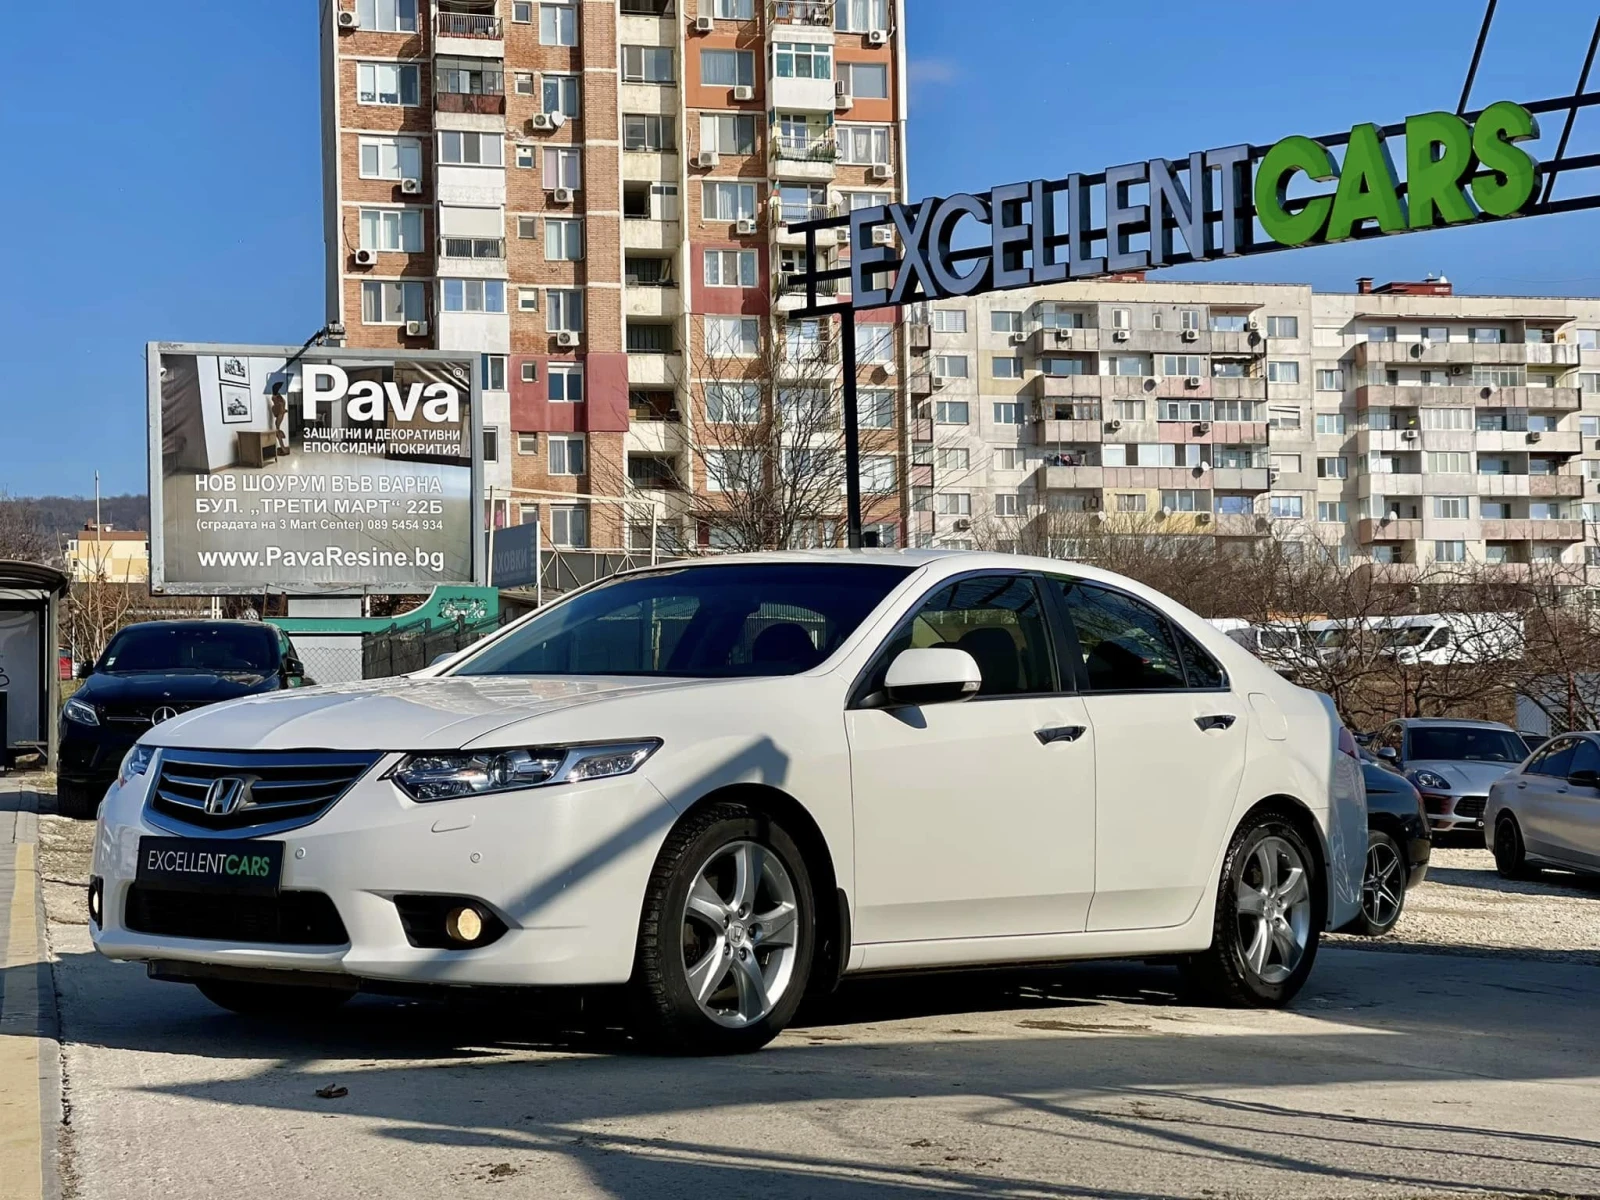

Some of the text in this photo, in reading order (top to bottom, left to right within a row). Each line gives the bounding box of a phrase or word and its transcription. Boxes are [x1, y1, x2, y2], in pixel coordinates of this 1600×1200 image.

[302, 363, 460, 423] Pava
[303, 427, 460, 441] ЗАЩИТНИ И ДЕКОРАТИВНИ
[303, 441, 460, 455] ЕПОКСИДНИ ПОКРИТИЯ
[195, 474, 443, 493] НОВ ШОУРУМ ВЪВ ВАРНА
[195, 498, 244, 513] БУЛ.
[406, 500, 443, 514] 22Б
[196, 518, 443, 531] (сградата на 3 Mart Center) 089 5454 934
[197, 546, 444, 572] www.PavaResine.bg
